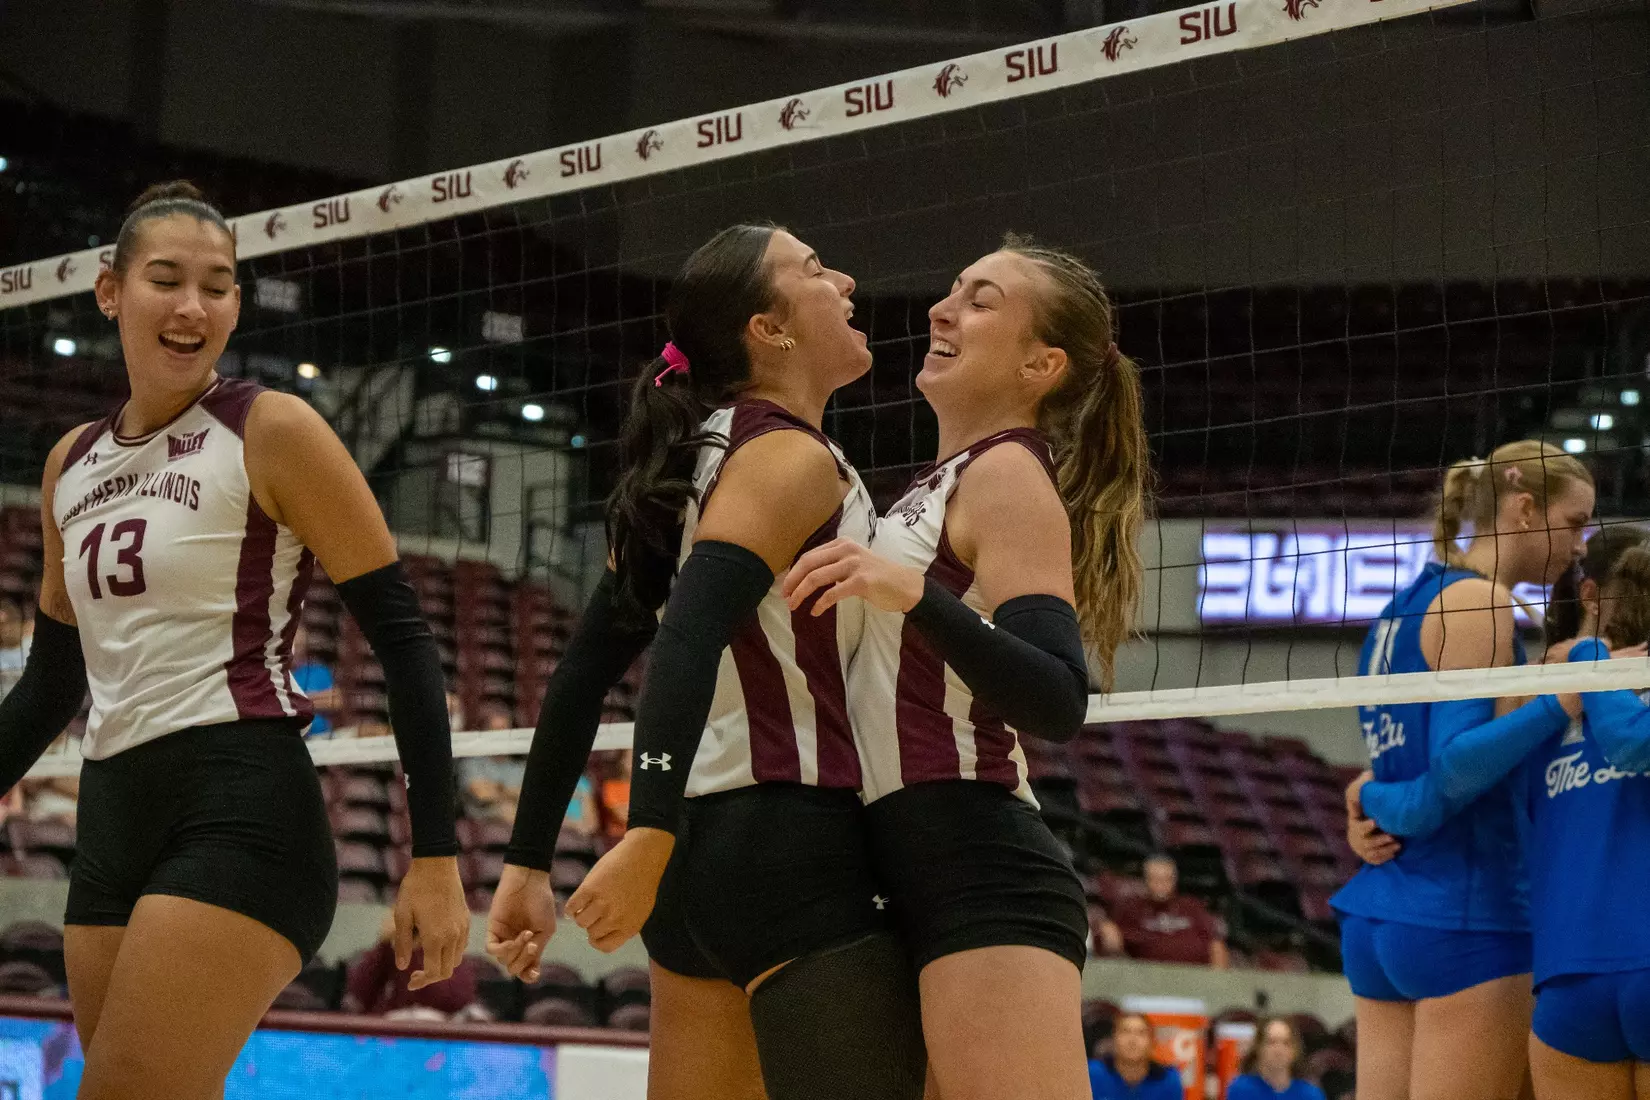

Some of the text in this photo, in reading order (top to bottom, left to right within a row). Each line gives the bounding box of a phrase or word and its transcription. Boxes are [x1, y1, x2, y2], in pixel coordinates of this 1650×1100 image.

[1, 2, 1238, 294] SIU SIU SIU SIU SIU SIU SIU SIU
[60, 470, 202, 532] OUTHERN ILLINOIS
[79, 518, 148, 600] 13
[1545, 750, 1592, 799] The
